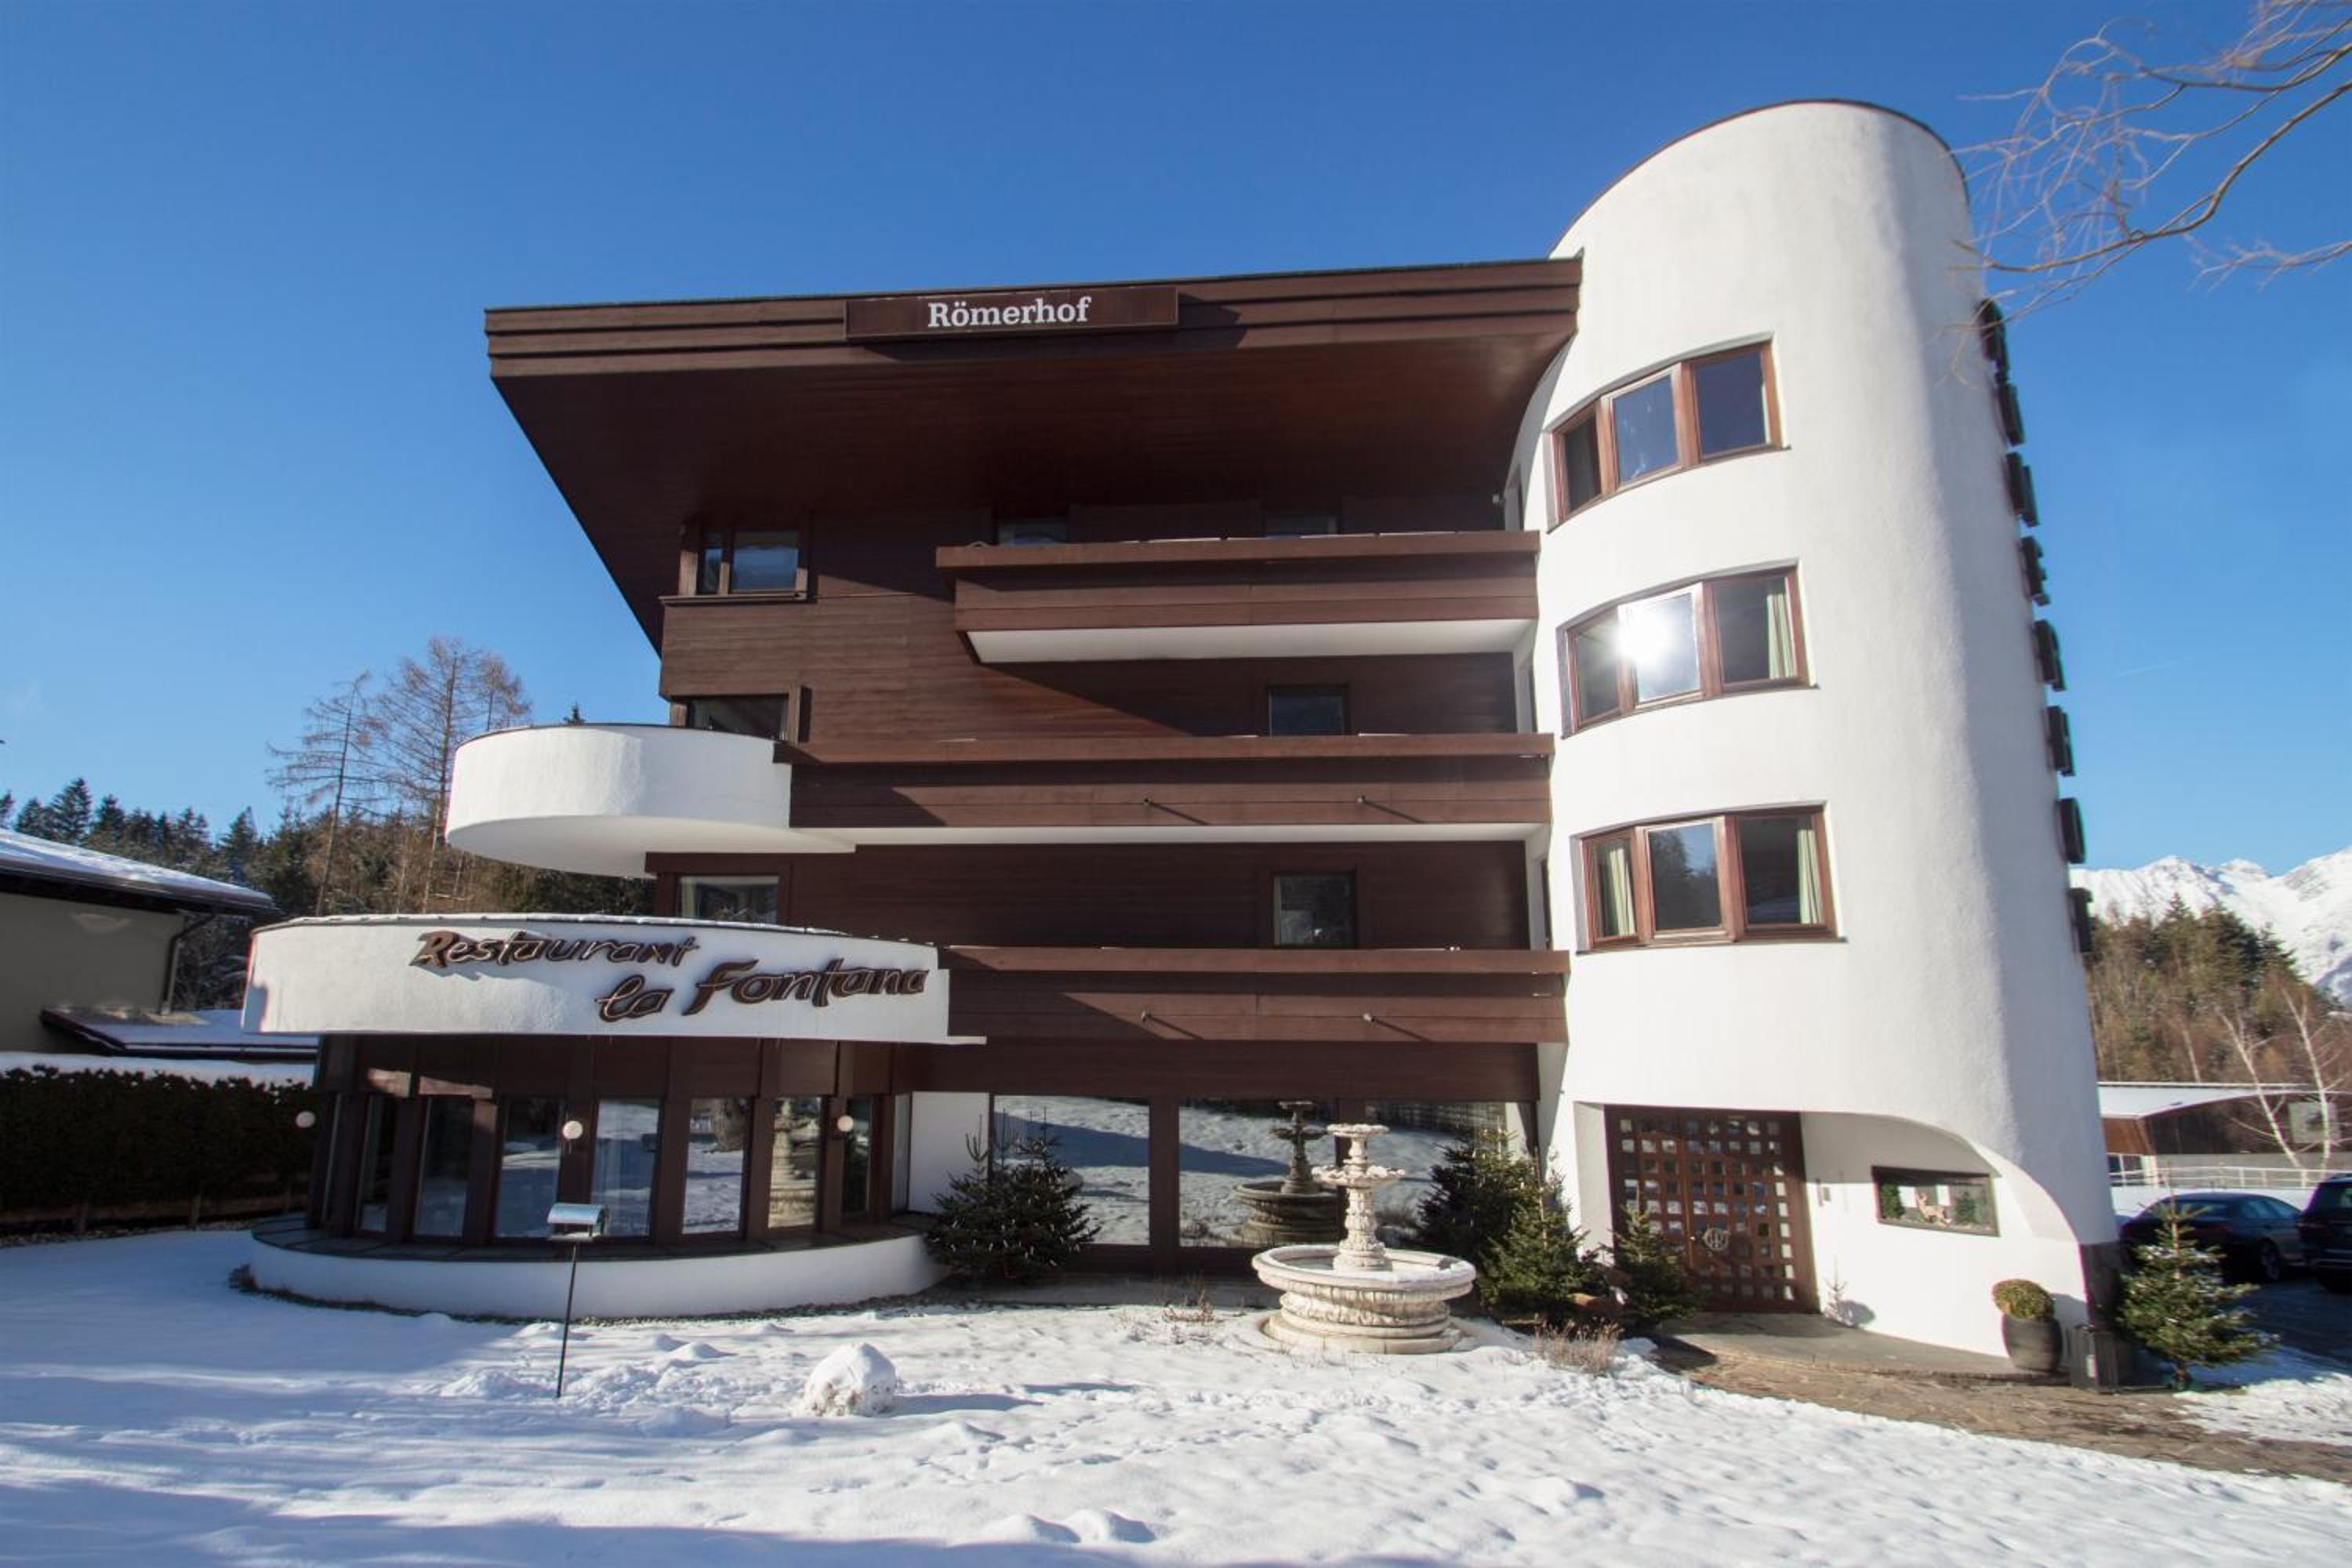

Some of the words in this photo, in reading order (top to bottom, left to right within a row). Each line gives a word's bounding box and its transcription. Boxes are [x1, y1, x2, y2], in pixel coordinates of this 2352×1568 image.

[927, 296, 1091, 328] Römerhof
[409, 930, 700, 967] Restaurant
[681, 957, 930, 1016] Fontana
